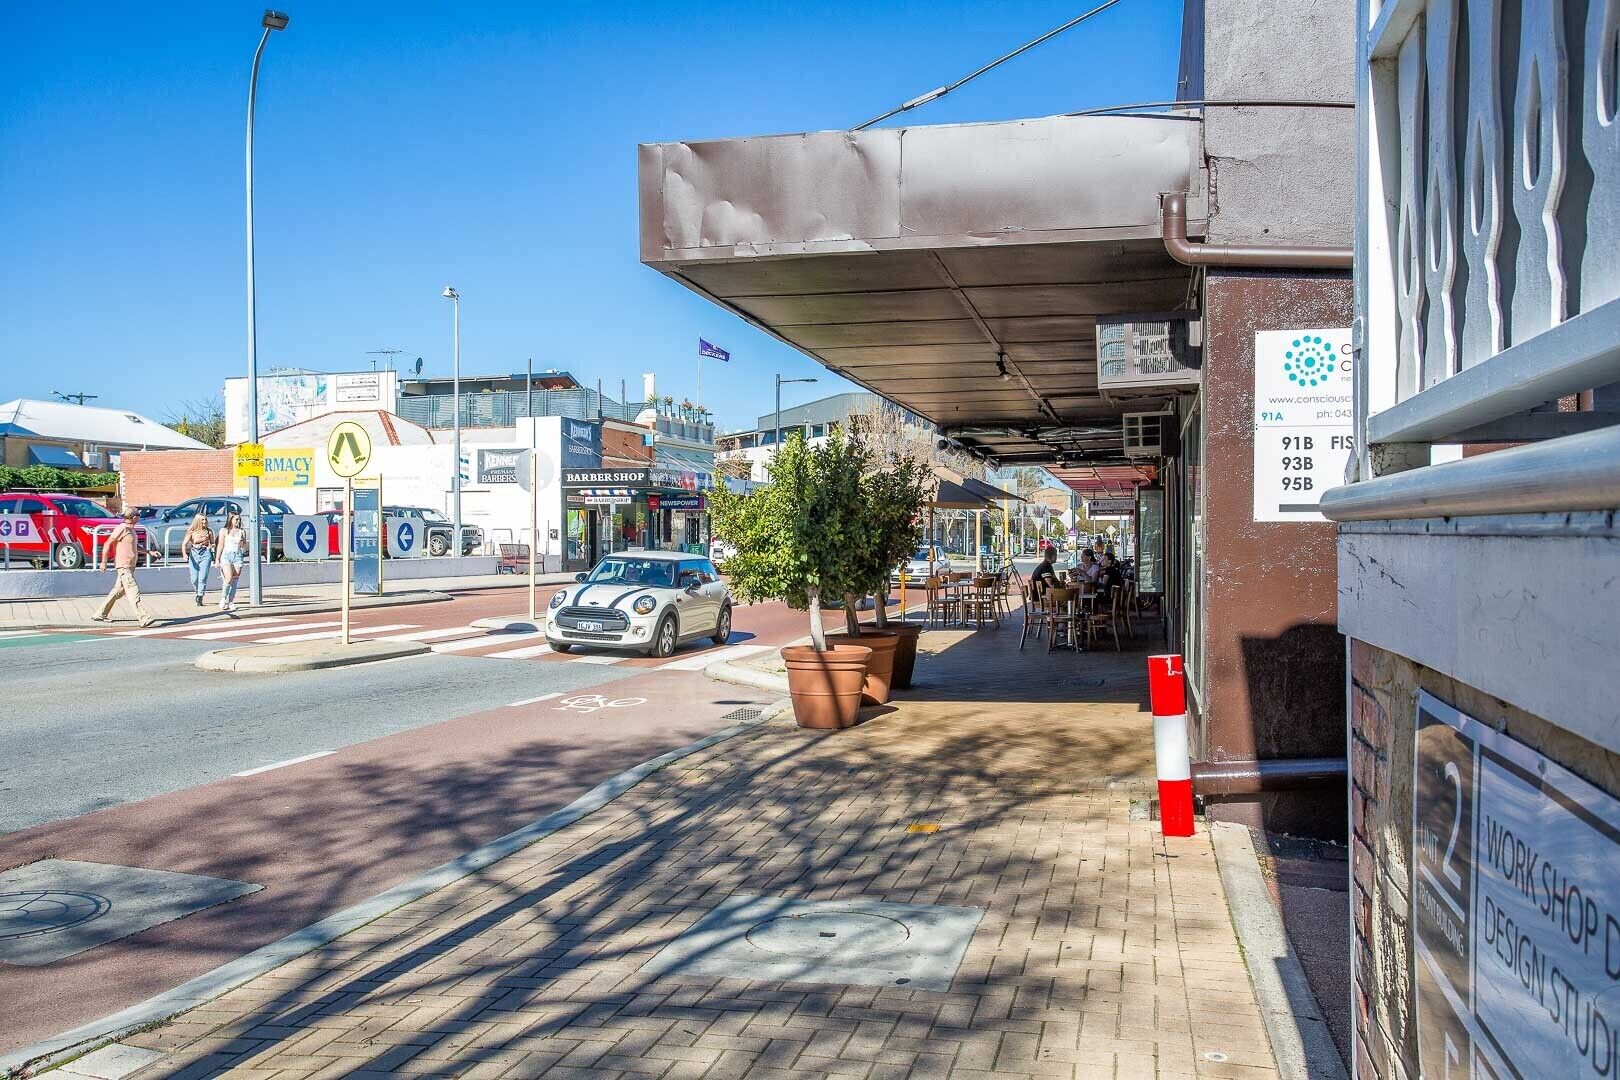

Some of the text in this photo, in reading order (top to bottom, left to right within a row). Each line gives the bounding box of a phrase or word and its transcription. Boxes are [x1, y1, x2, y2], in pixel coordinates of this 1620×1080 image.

[1261, 412, 1284, 421] 91A
[1316, 410, 1352, 420] ph: 043
[1282, 437, 1314, 450] 91B
[1331, 436, 1354, 450] FIS
[1282, 457, 1314, 470] 93B
[566, 473, 613, 482] BARBER
[613, 472, 645, 481] SHOP
[1282, 477, 1314, 491] 95B
[1442, 761, 1462, 891] 2
[1420, 821, 1439, 865] UNIT
[1484, 895, 1545, 1008] DESIGN
